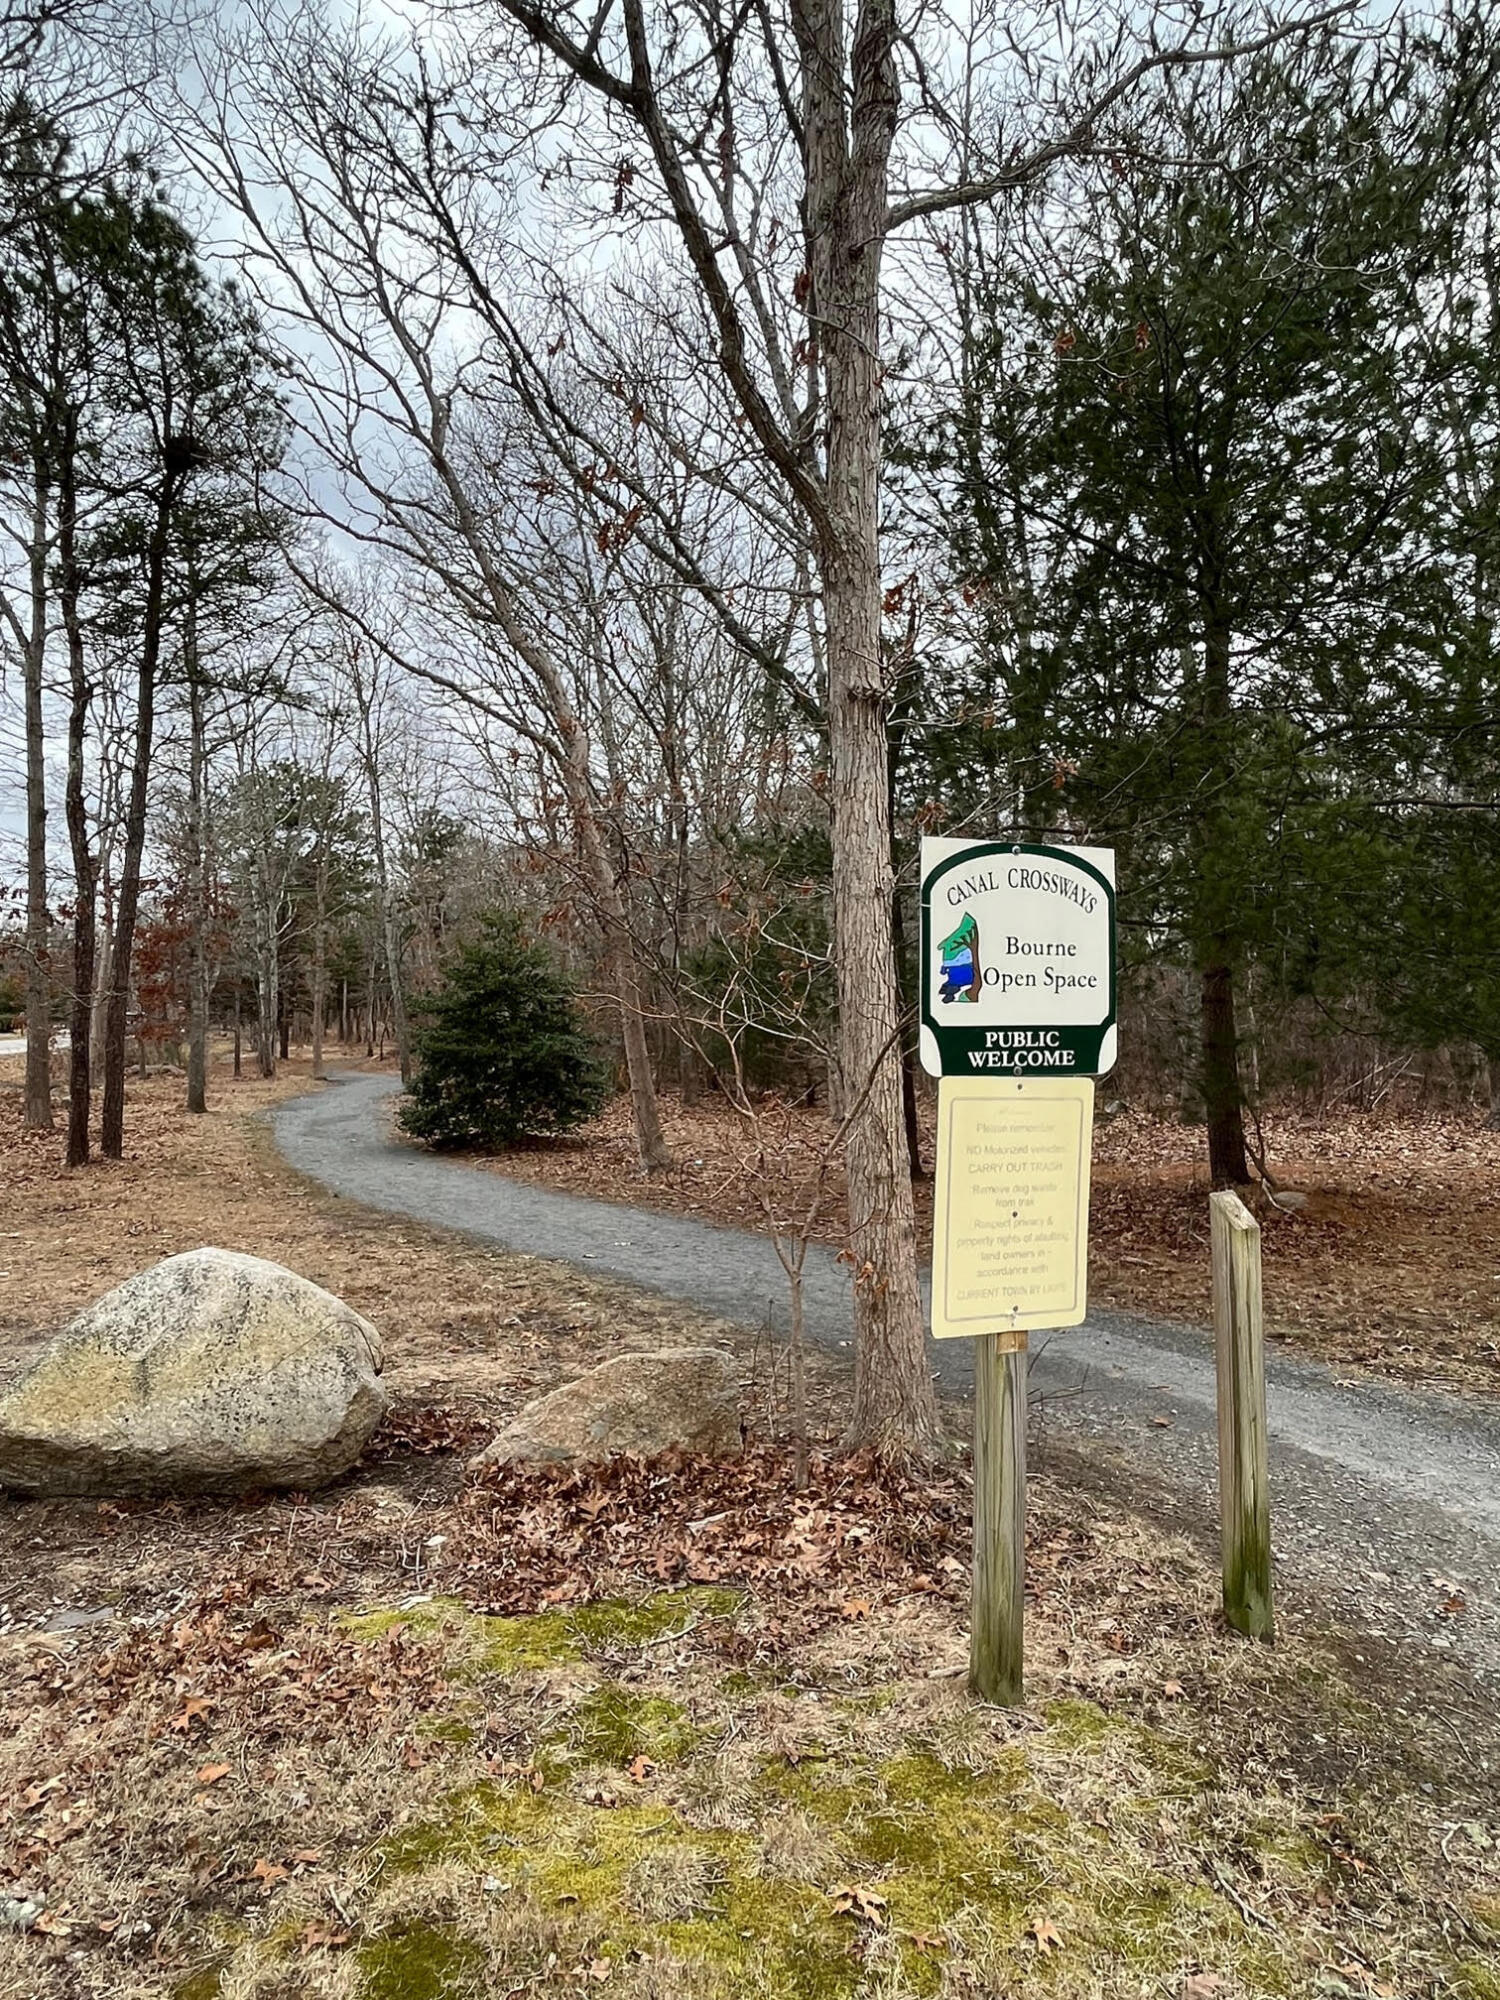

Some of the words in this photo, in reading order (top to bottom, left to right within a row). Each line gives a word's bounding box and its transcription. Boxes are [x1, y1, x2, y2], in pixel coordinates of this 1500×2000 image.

[946, 871, 999, 906] CANAL
[1007, 867, 1098, 914] CROSSWAYS
[1005, 936, 1077, 957] Bourne
[983, 966, 1037, 992] Open
[1043, 966, 1098, 994] Space
[985, 1031, 1061, 1048] PUBLIC
[967, 1050, 1076, 1068] WELCOME
[966, 1144, 982, 1155] NO
[968, 1162, 1003, 1174] CARRY
[1006, 1162, 1027, 1173] OUT
[1030, 1161, 1063, 1172] TRASH
[972, 1183, 1010, 1194] Remove
[1012, 1183, 1030, 1195] dog
[995, 1198, 1016, 1208] from
[1013, 1218, 1044, 1230] privacy
[956, 1235, 994, 1248] property
[996, 1234, 1021, 1247] rights
[1023, 1233, 1033, 1243] of
[980, 1251, 1001, 1261] land
[1003, 1250, 1035, 1260] owners
[976, 1265, 1030, 1278] accordance
[1002, 1285, 1028, 1298] TOWN
